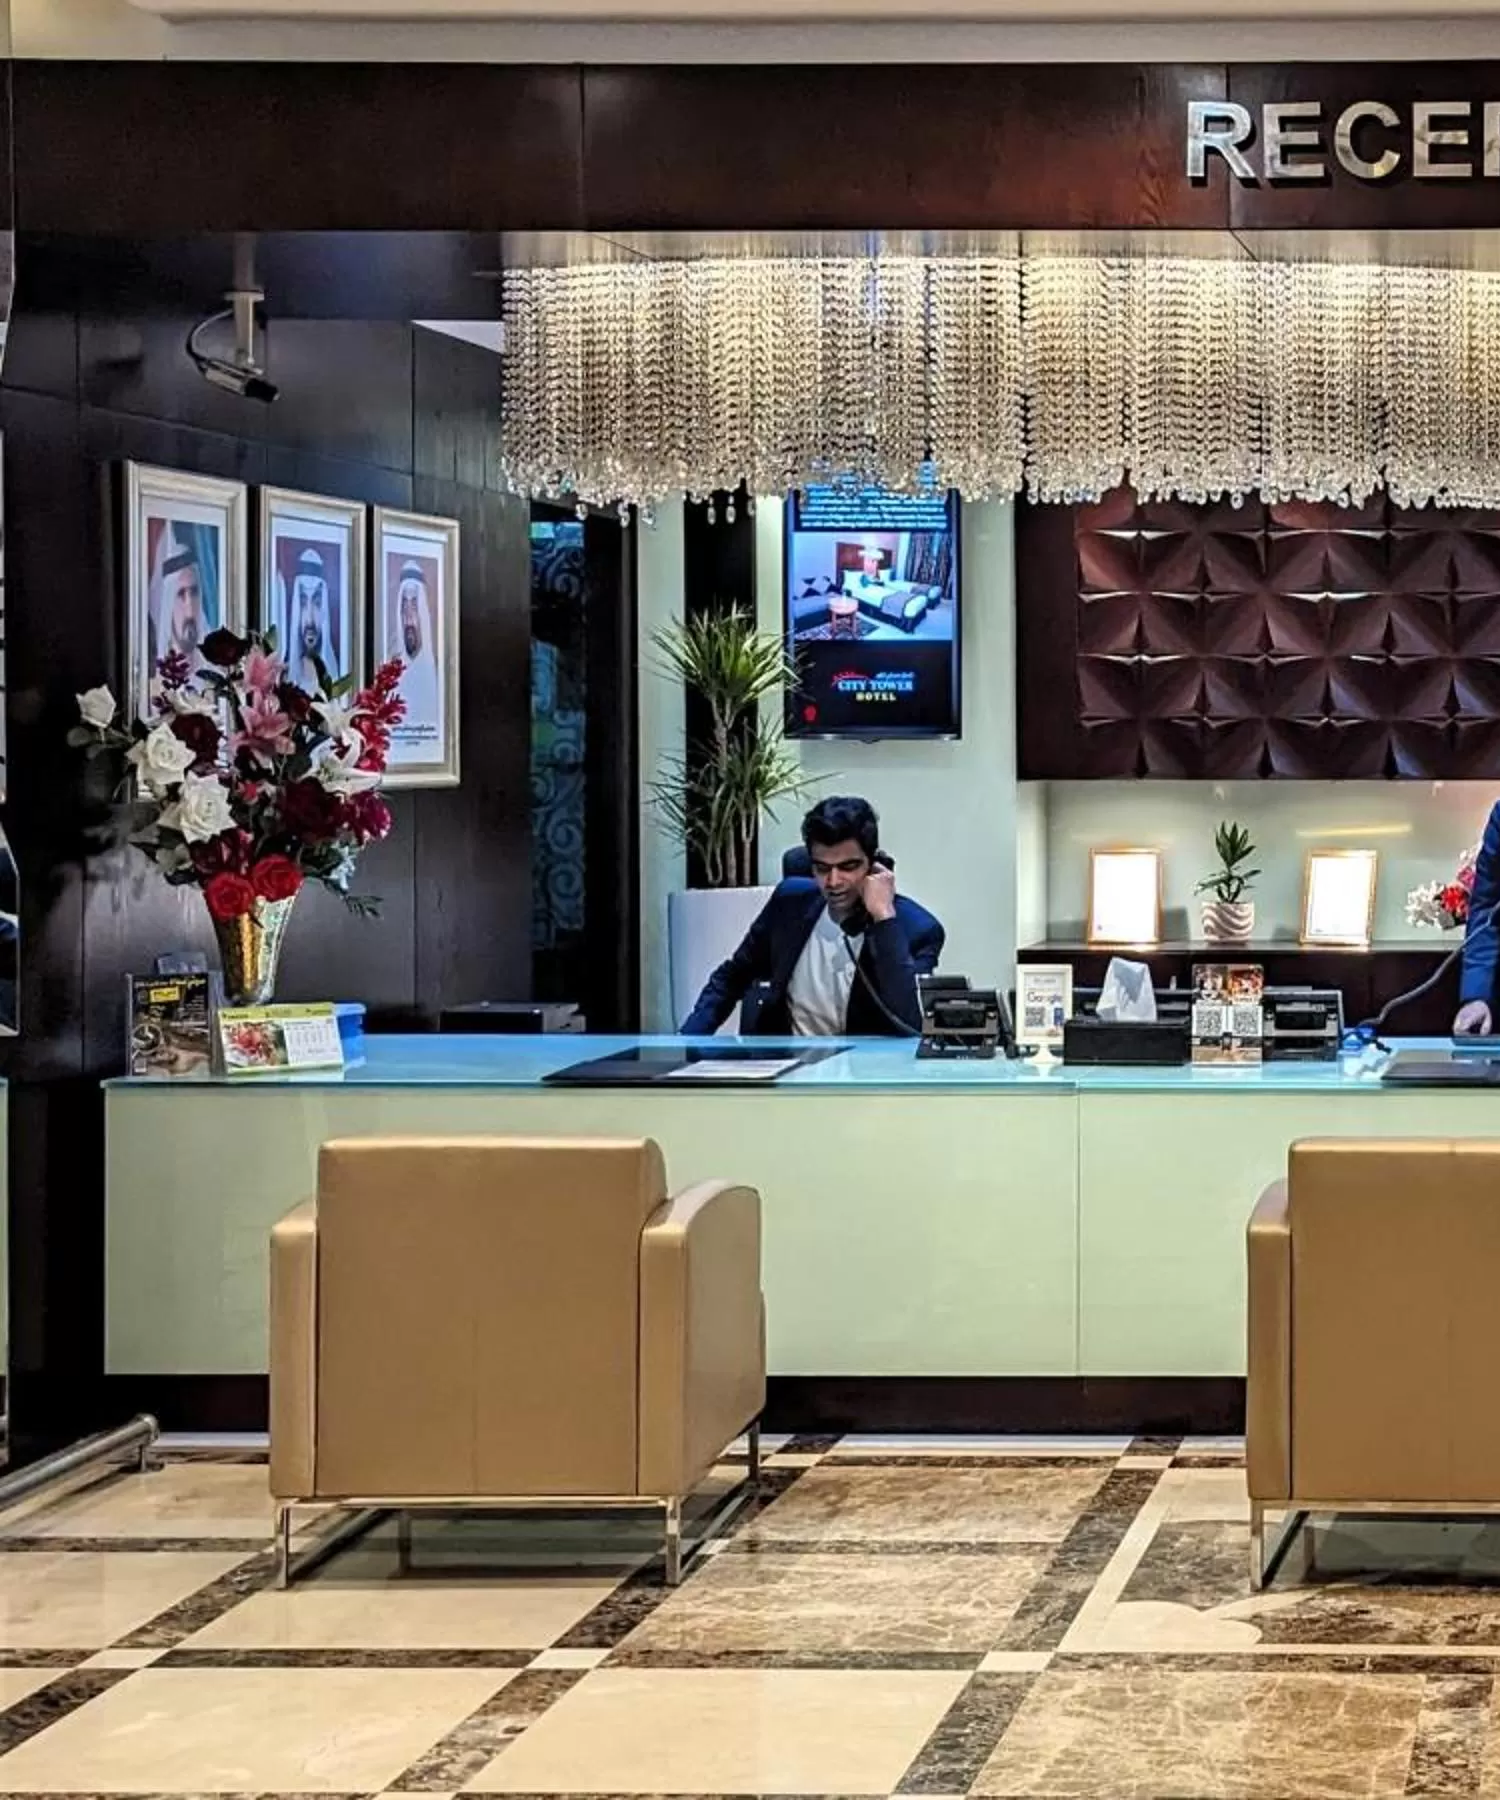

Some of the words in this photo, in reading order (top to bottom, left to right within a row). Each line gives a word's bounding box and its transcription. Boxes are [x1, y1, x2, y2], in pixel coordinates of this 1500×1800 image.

[837, 680, 867, 692] CITY
[870, 680, 913, 692] TOWER
[855, 692, 897, 702] HOTEL
